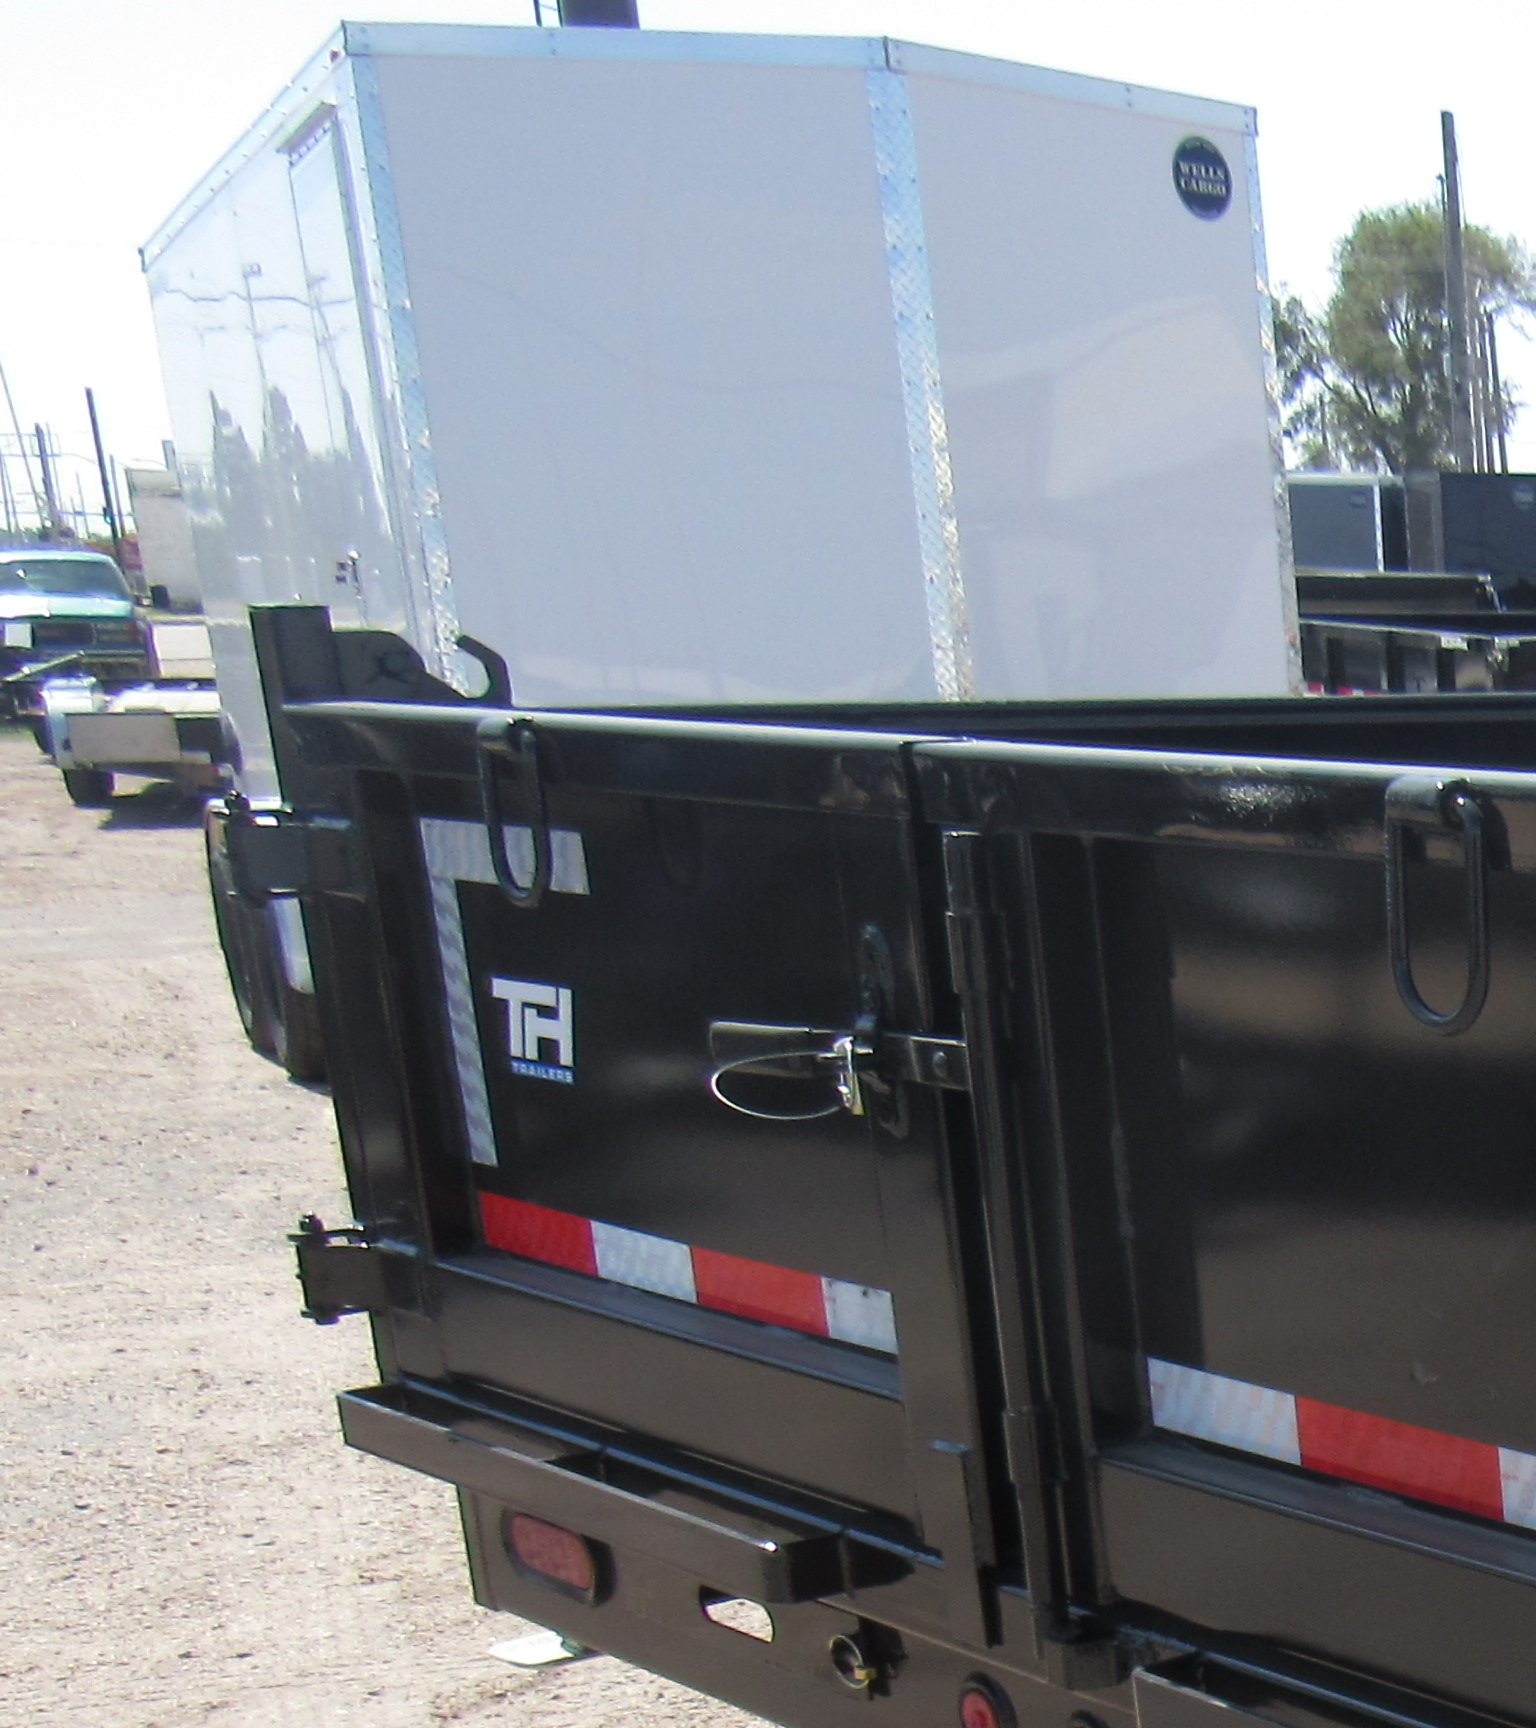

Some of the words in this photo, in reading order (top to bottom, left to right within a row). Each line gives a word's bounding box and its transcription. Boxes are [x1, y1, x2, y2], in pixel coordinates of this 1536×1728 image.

[1178, 160, 1225, 182] WELLS
[1180, 177, 1227, 198] CARGO
[491, 976, 575, 1067] TH
[511, 1061, 575, 1084] TRAILERS
